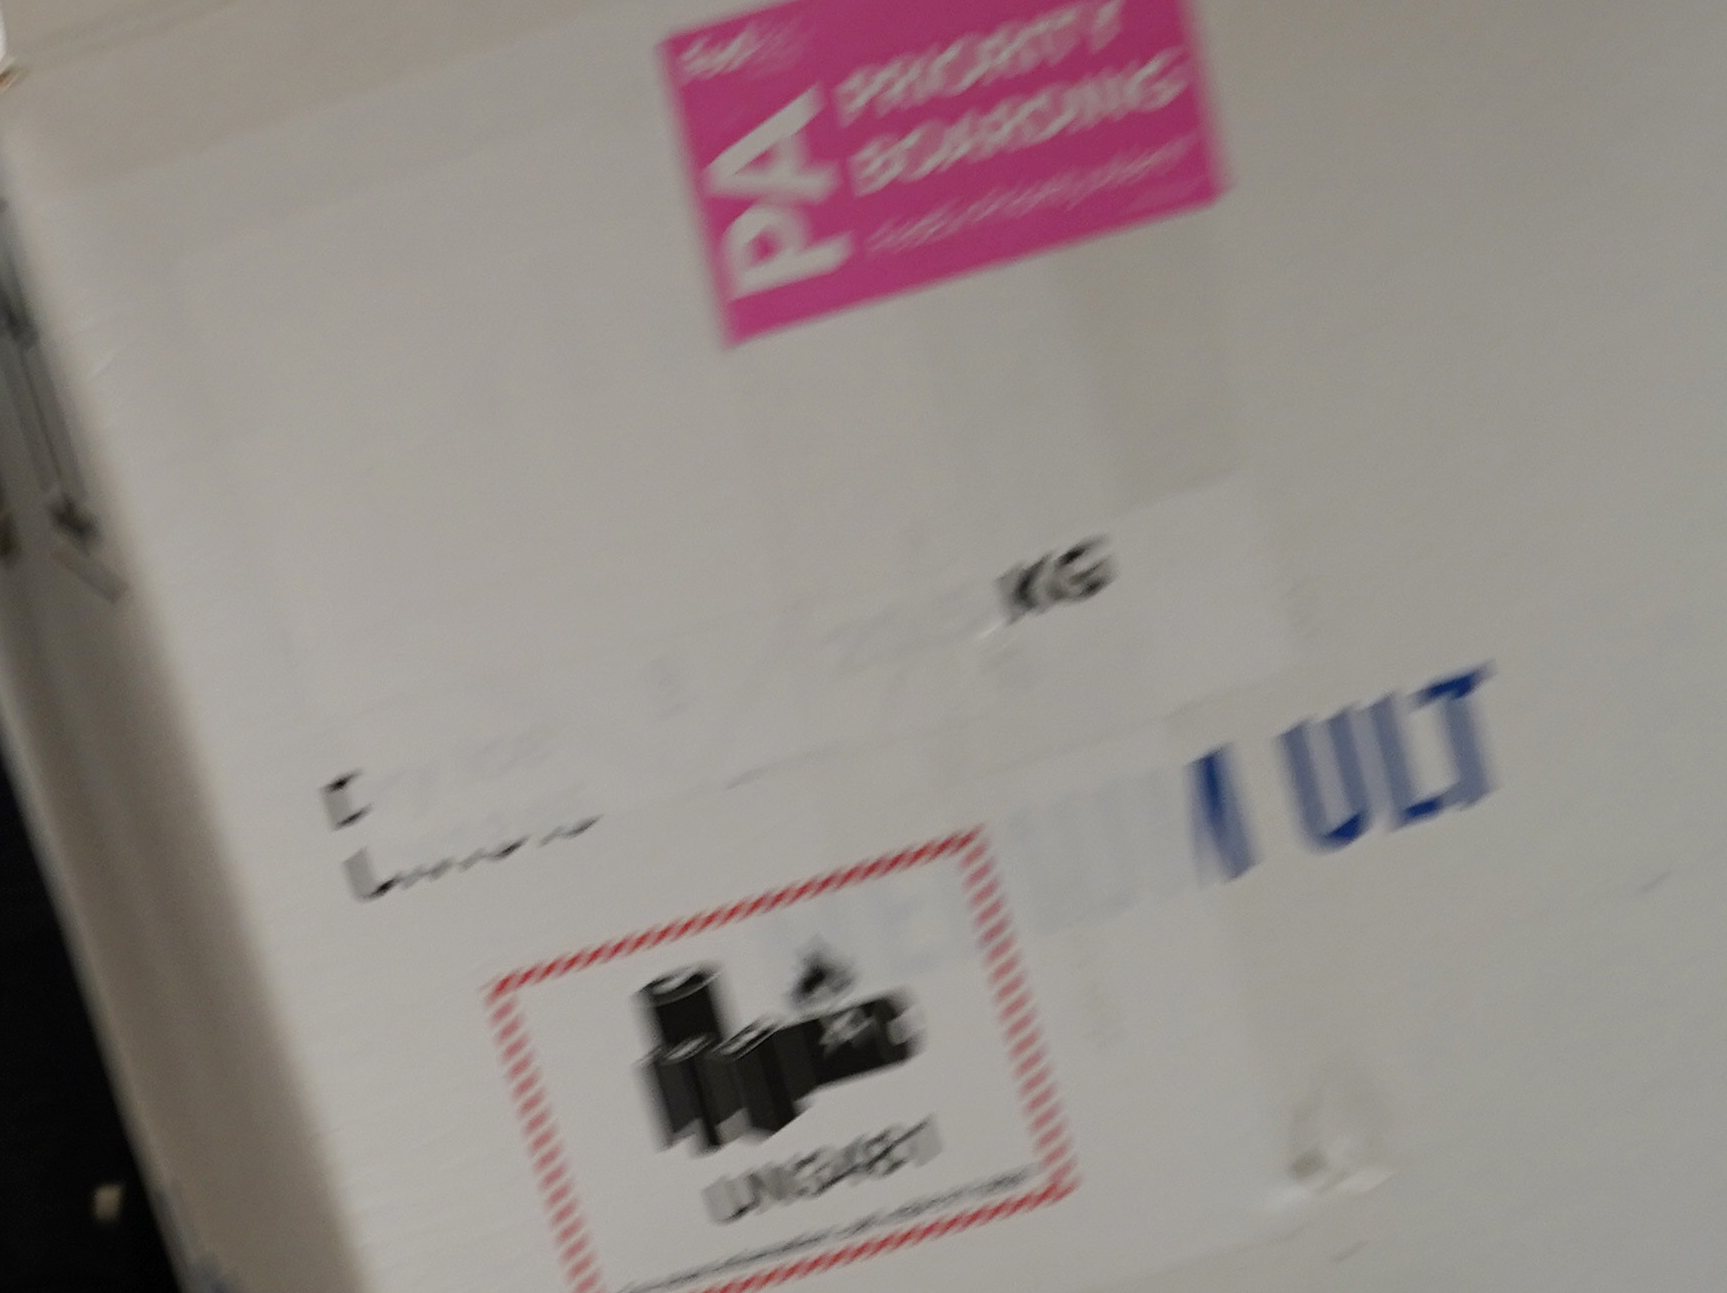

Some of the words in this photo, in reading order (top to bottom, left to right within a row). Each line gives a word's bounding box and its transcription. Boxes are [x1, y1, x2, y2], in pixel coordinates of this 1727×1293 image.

[702, 81, 854, 304] PA
[996, 534, 1118, 626] KG
[1270, 658, 1501, 856] ULT
